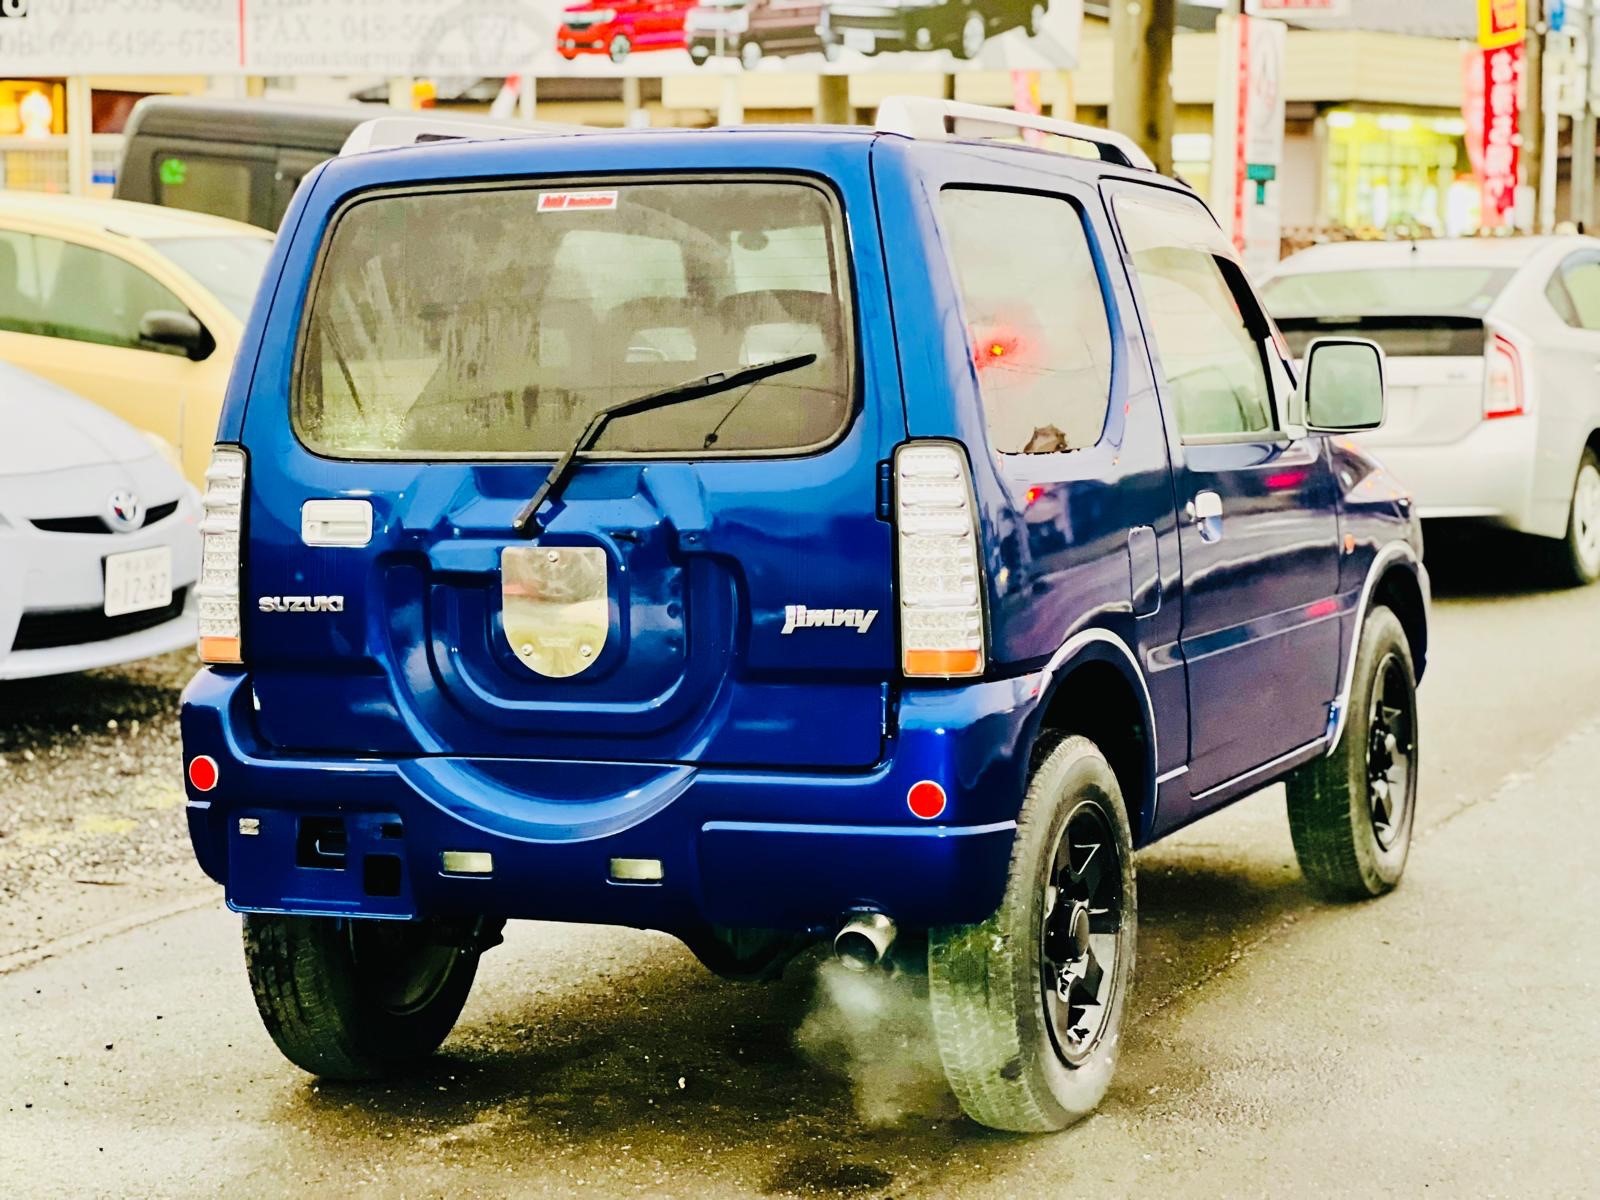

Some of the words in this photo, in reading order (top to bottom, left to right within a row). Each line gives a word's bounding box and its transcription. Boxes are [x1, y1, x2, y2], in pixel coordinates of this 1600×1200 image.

[252, 13, 311, 44] FAX
[258, 595, 344, 612] SUZUKI
[780, 605, 879, 634] Jimny
